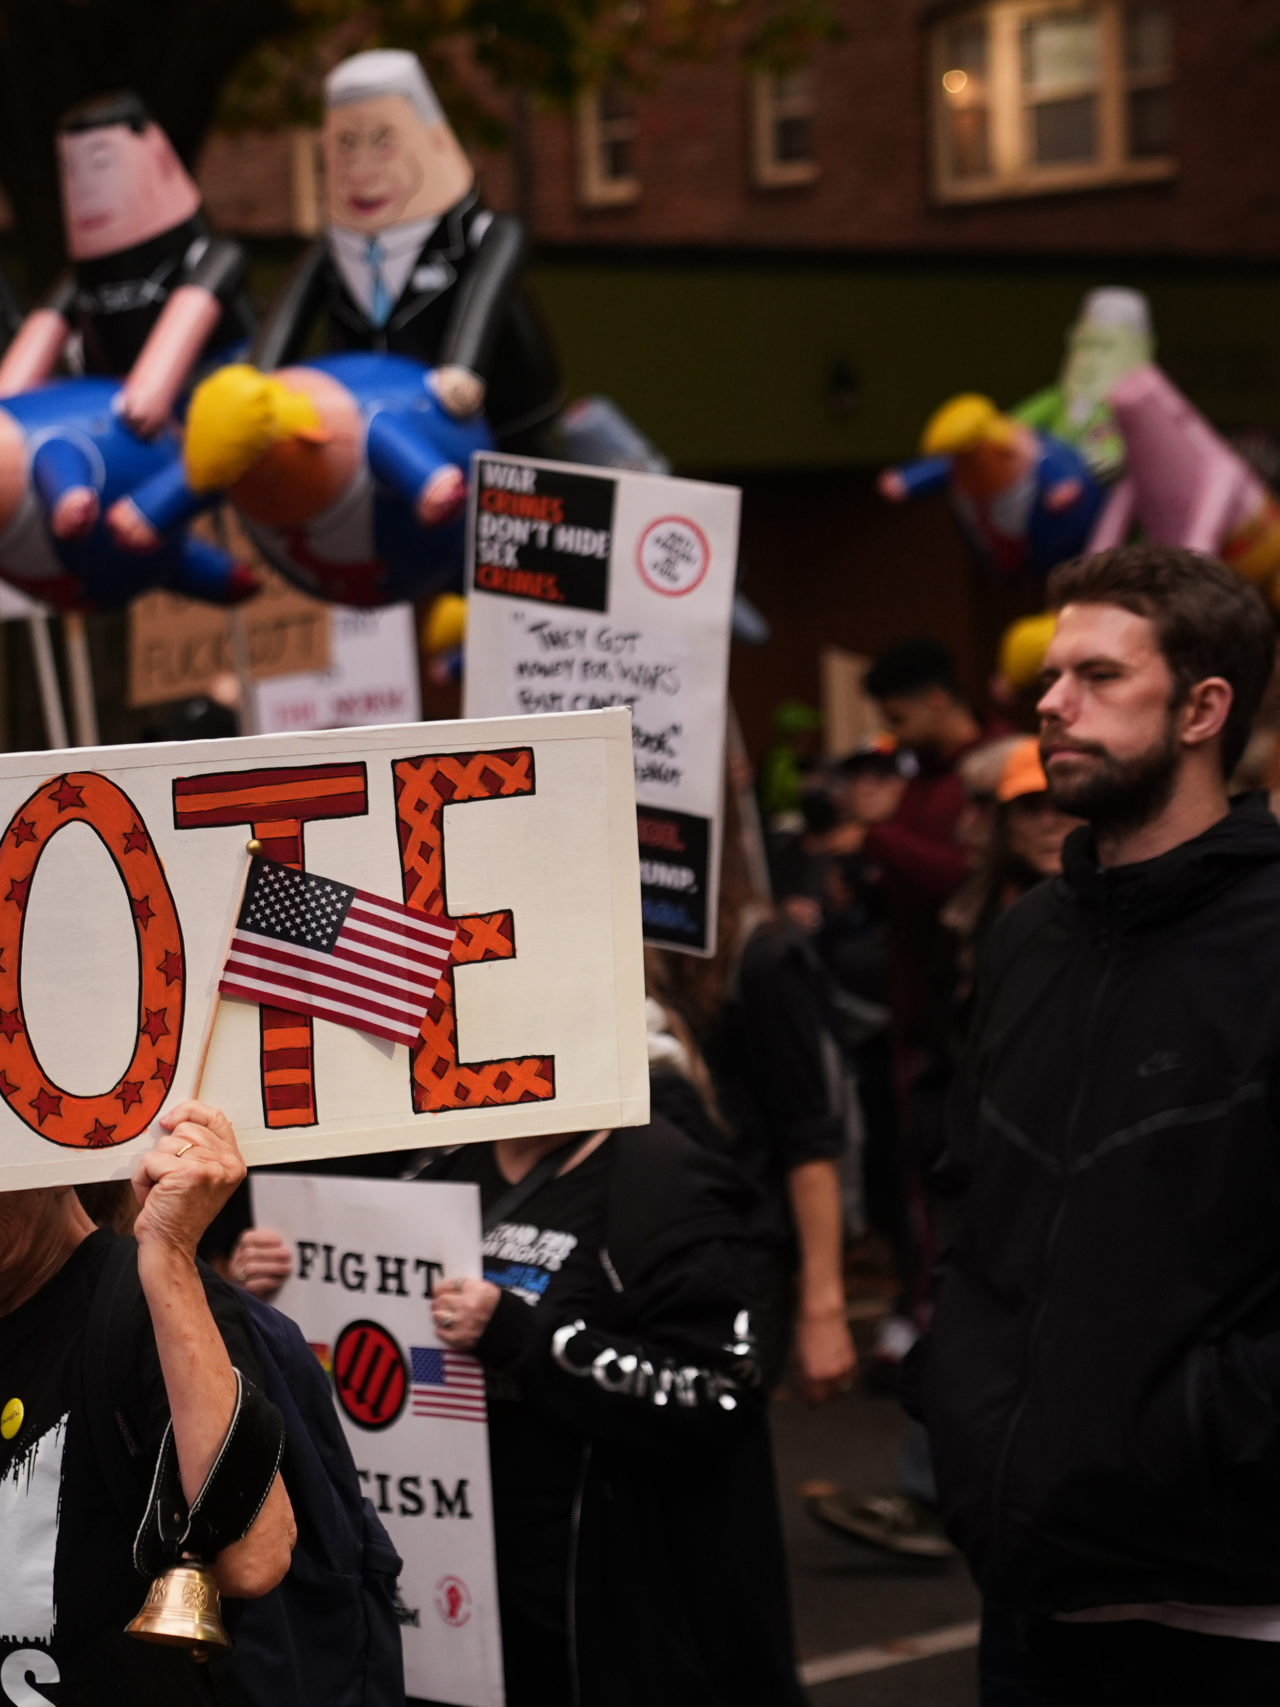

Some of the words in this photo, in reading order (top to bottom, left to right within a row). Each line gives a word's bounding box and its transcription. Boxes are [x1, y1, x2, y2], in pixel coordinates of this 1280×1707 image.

[482, 463, 537, 494] WAR
[481, 488, 565, 524] CRIMES
[479, 512, 552, 548] DON'T
[554, 526, 610, 559] HIDE
[479, 541, 519, 568] SEX
[639, 858, 698, 895] UMP.
[296, 1240, 444, 1300] FIGHT
[357, 1469, 473, 1520] ISM
